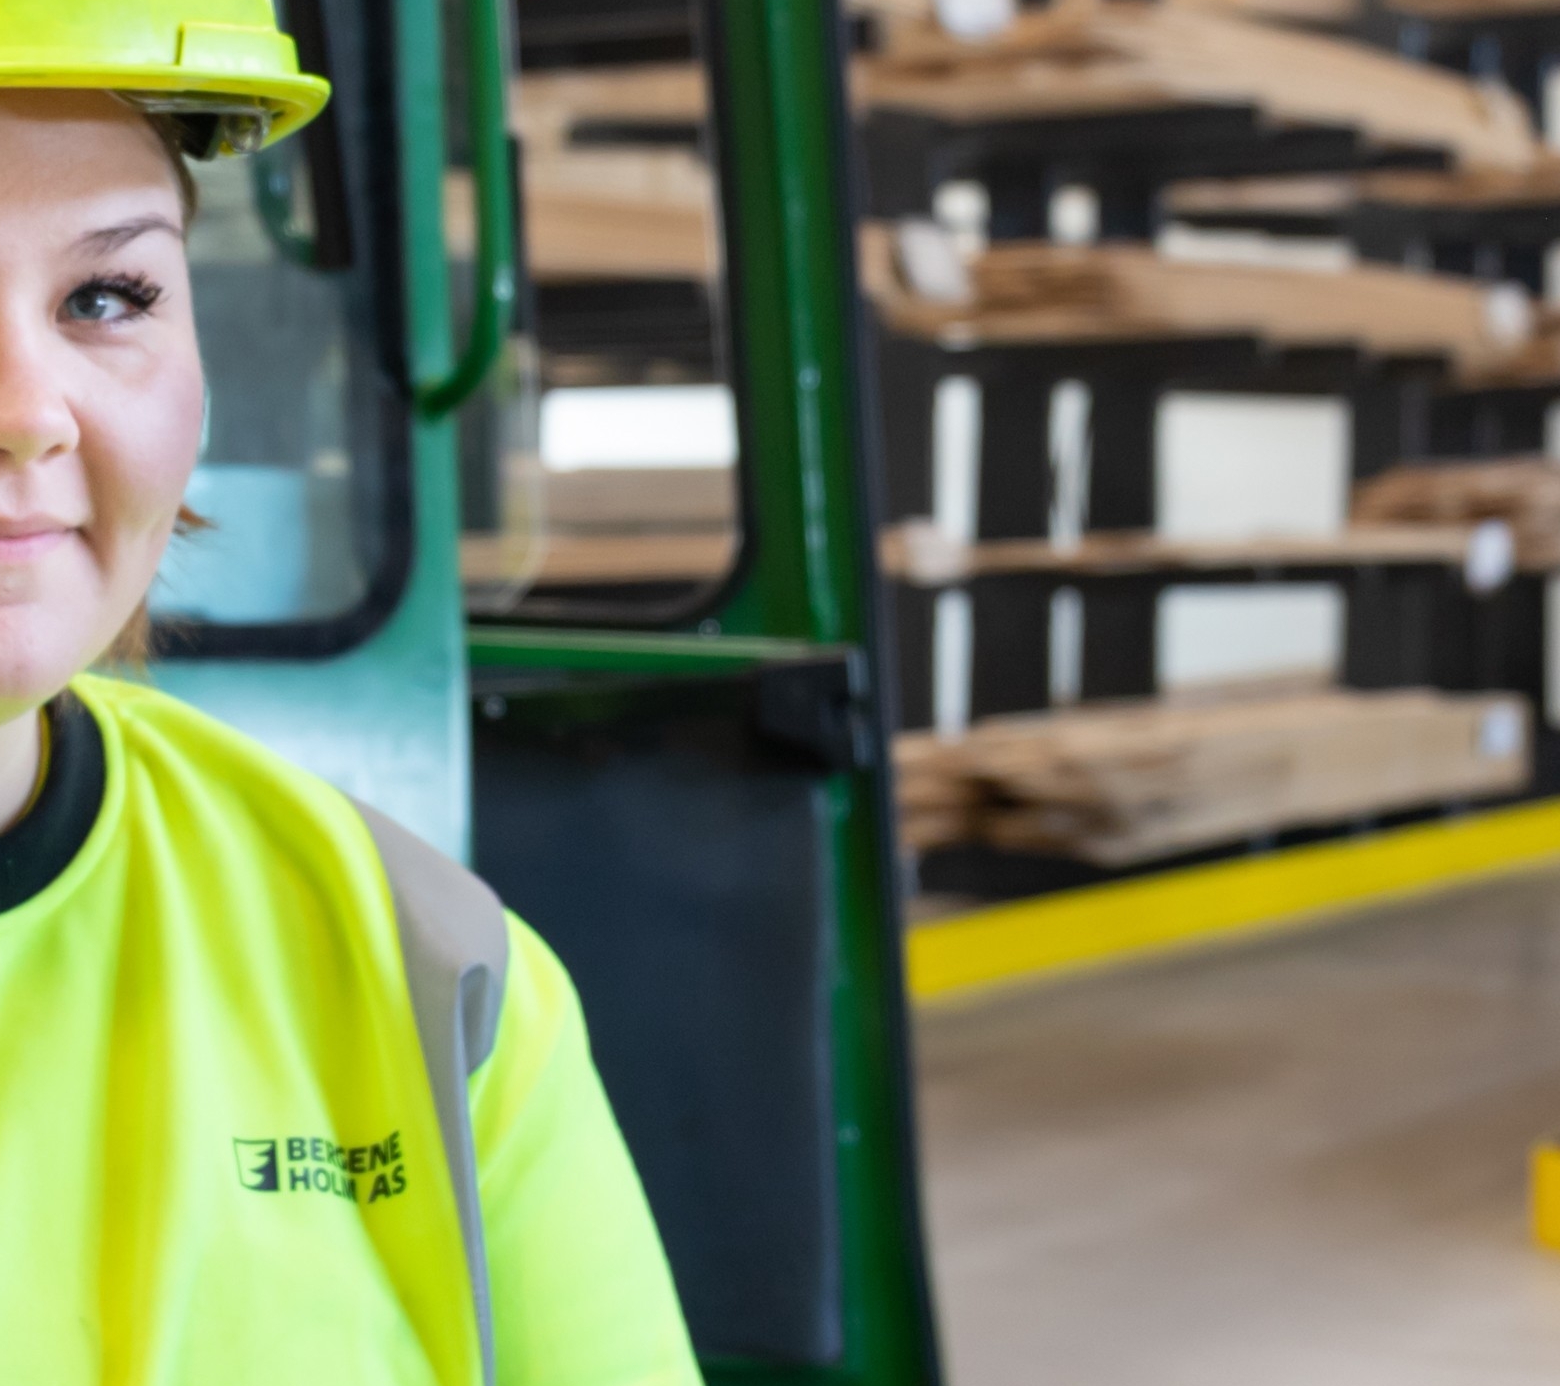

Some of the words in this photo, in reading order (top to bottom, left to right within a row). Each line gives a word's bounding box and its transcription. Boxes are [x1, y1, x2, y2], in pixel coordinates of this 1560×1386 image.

[286, 1130, 403, 1174] BERGENE
[288, 1167, 358, 1204] HOLM
[367, 1164, 407, 1204] AS
